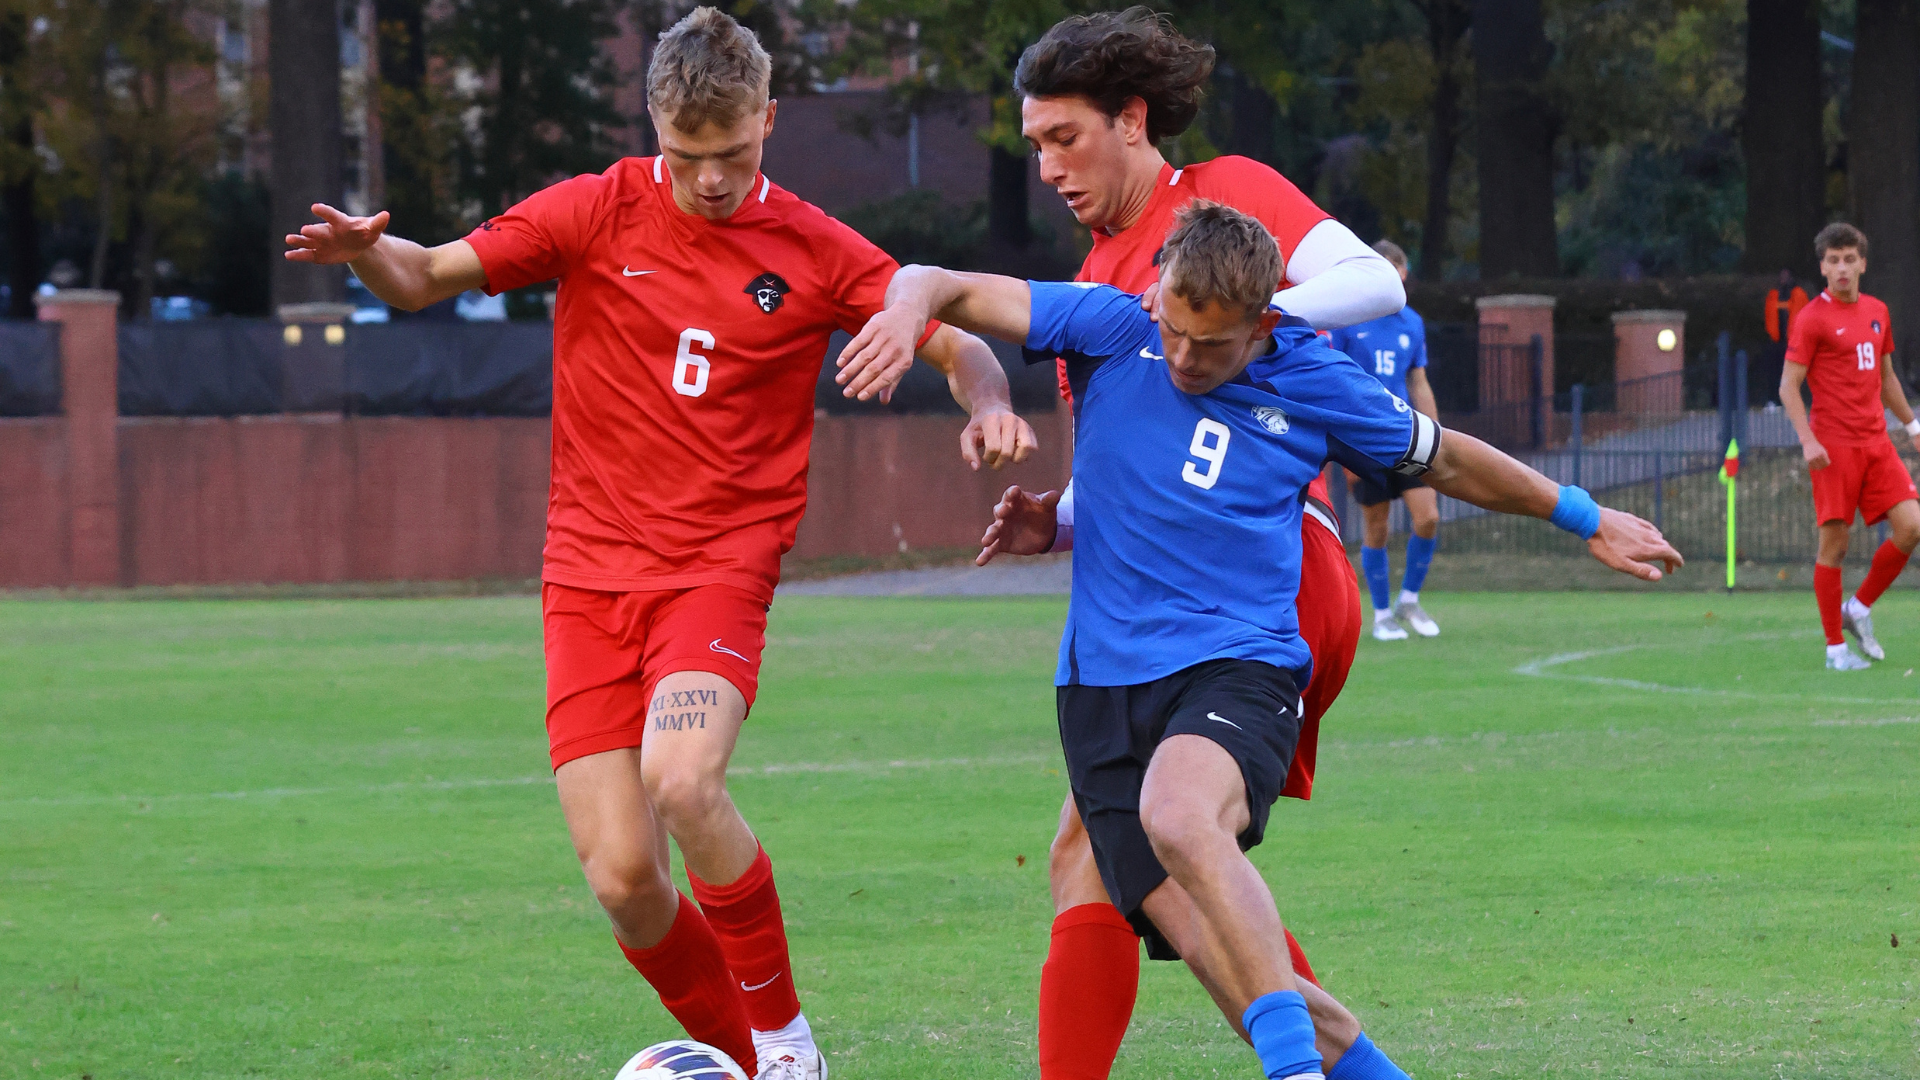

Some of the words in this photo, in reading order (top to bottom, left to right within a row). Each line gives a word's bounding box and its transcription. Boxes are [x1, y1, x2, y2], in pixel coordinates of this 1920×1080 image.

[672, 327, 715, 397] 6
[1375, 349, 1395, 376] 15
[1856, 341, 1875, 371] 19
[1181, 417, 1231, 490] 9
[654, 712, 706, 732] MMVI
